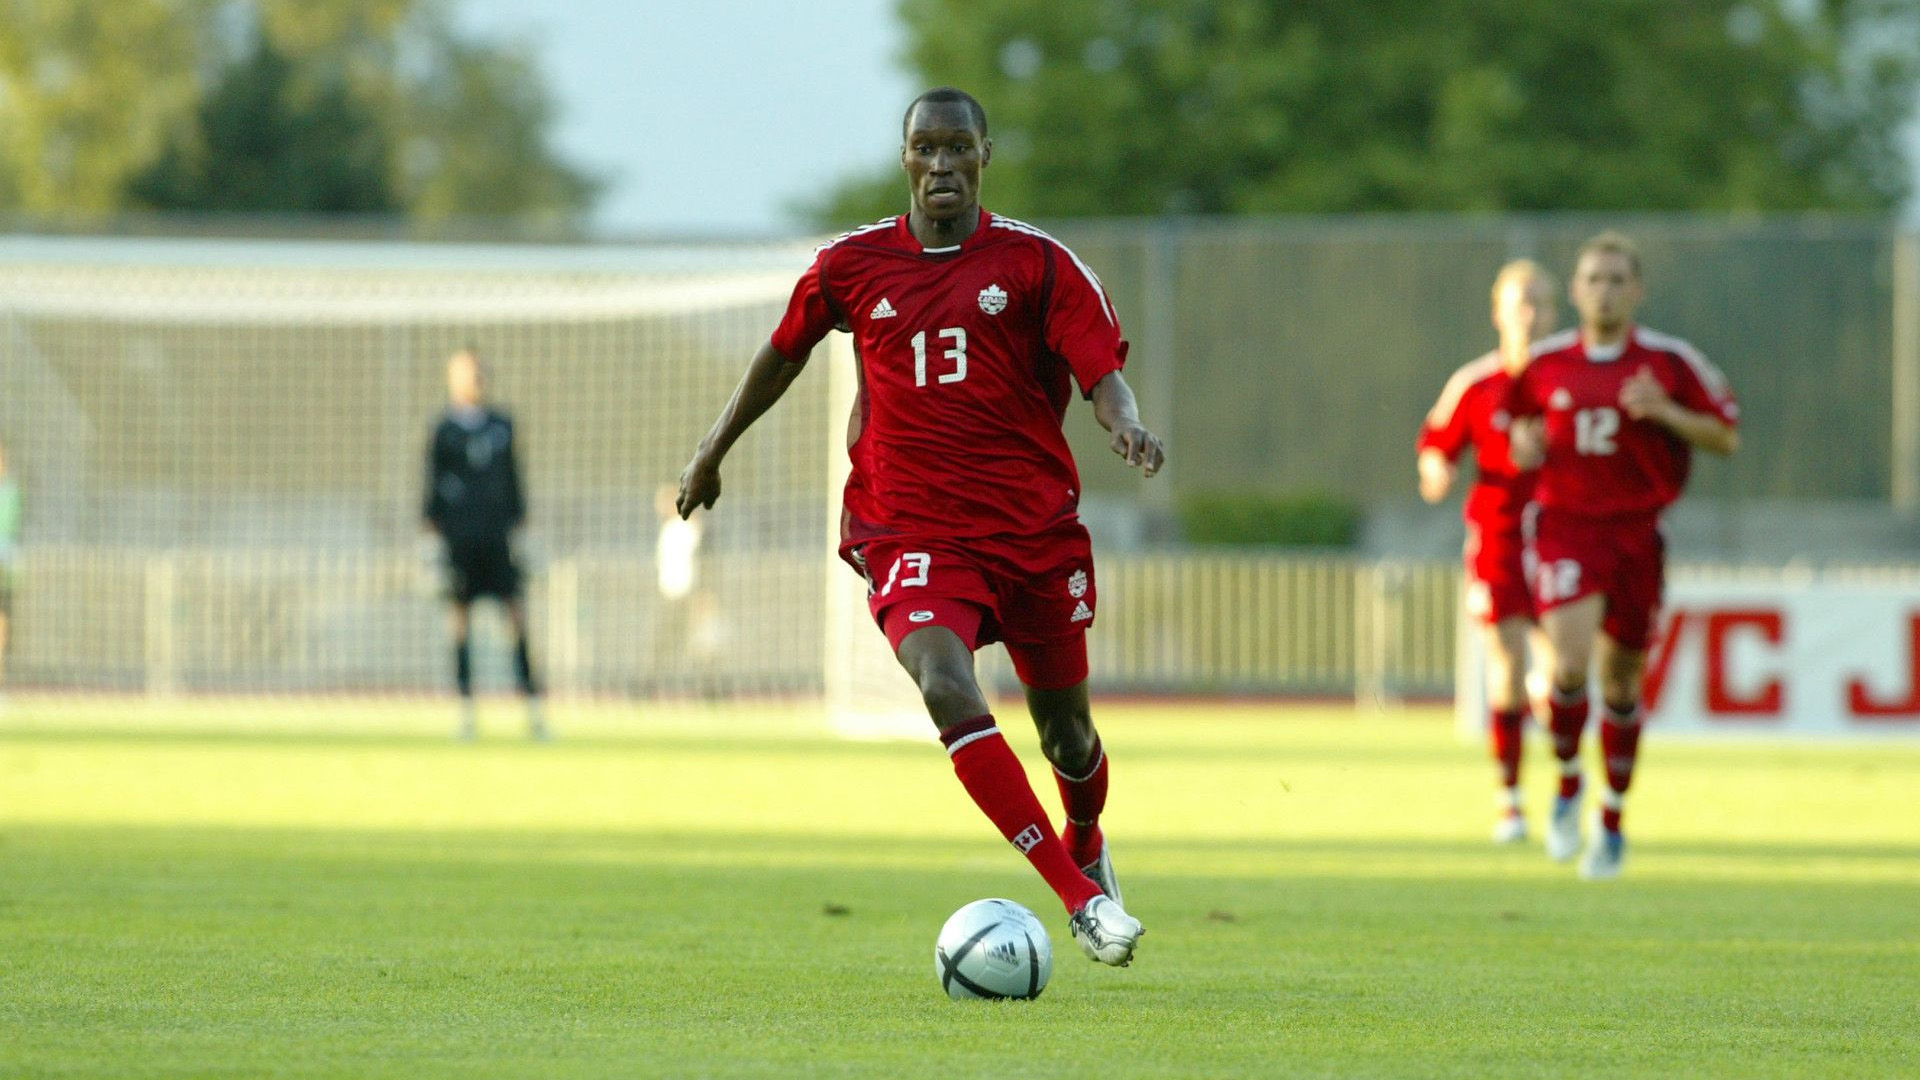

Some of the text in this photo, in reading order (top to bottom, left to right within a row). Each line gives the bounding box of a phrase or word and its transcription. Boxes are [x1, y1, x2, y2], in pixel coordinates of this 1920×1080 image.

[911, 327, 967, 387] 13
[1575, 408, 1619, 456] 12
[881, 552, 931, 597] 13
